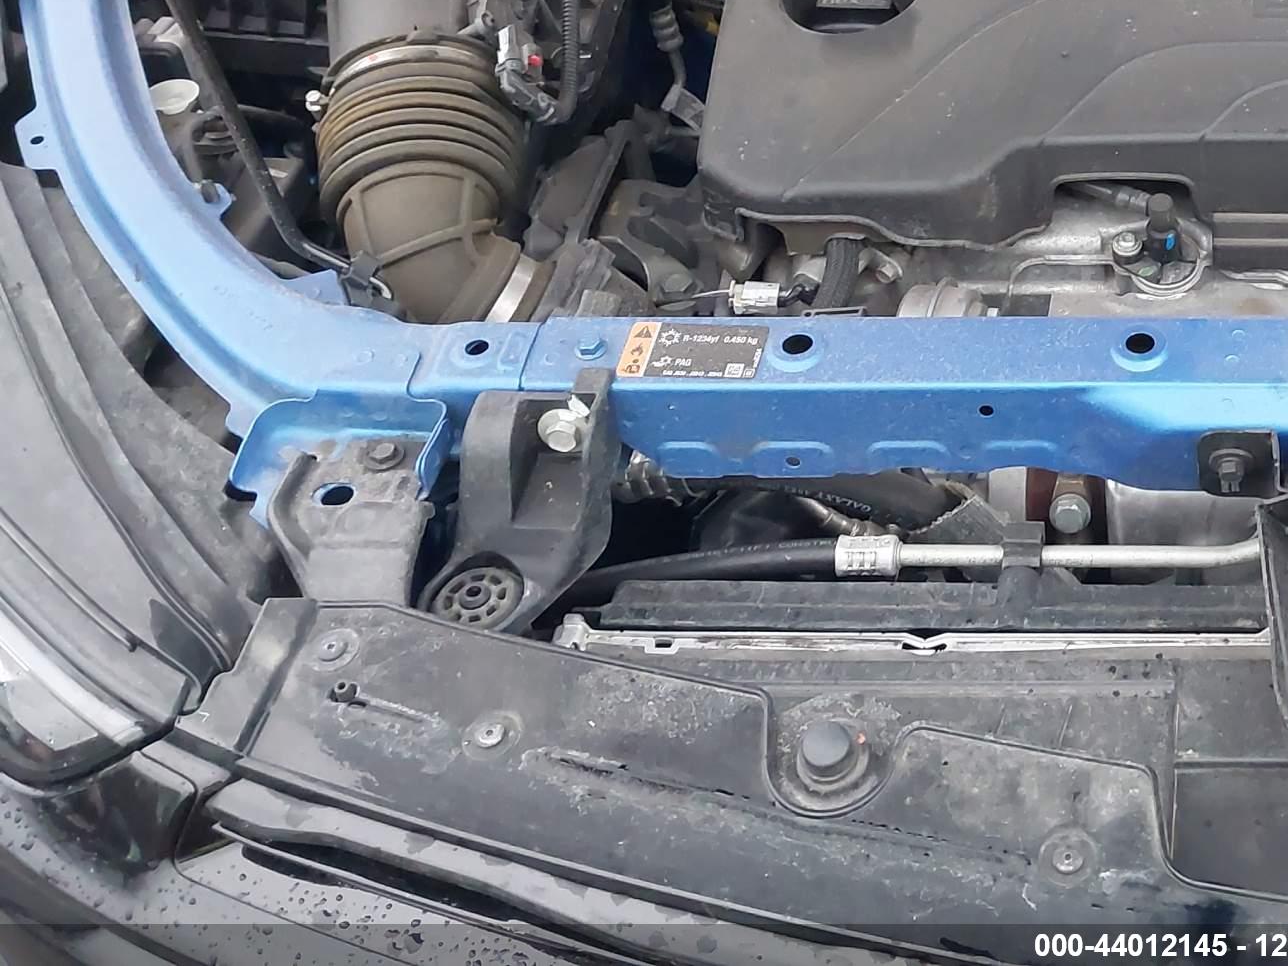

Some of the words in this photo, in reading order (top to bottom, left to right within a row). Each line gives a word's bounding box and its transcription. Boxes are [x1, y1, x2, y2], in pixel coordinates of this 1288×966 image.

[682, 335, 720, 344] R-1234yf
[747, 337, 759, 345] kg
[674, 358, 692, 367] PAG
